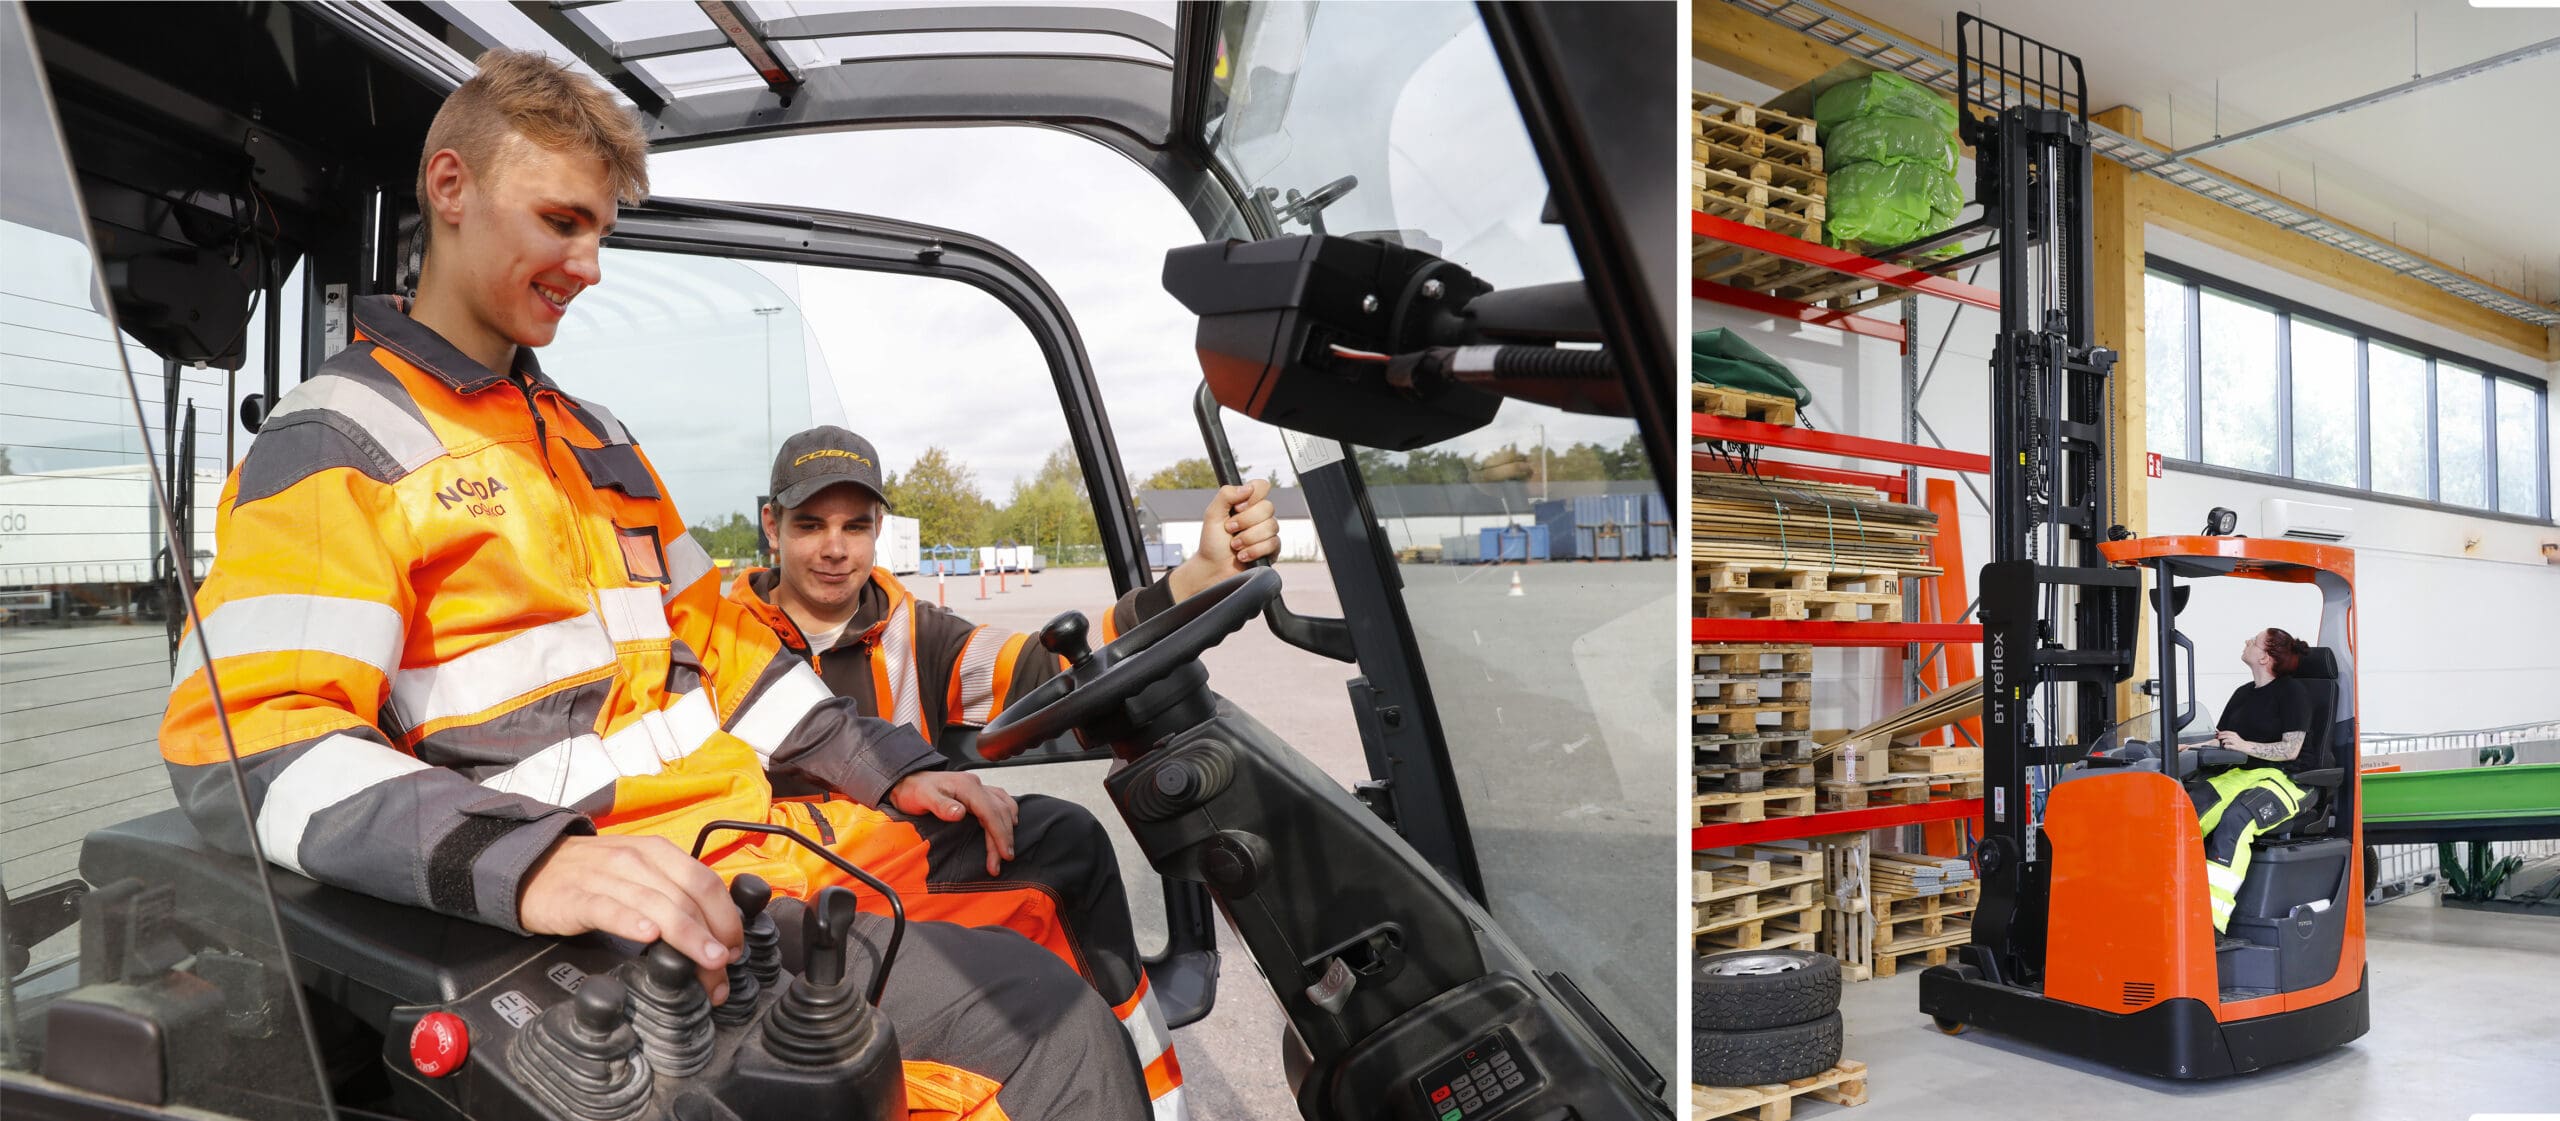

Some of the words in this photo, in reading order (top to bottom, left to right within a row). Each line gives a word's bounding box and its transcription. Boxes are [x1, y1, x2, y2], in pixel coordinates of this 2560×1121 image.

[793, 449, 872, 467] COBRA
[435, 476, 509, 511] NODA
[466, 503, 506, 518] loa
[1884, 580, 1897, 594] FIN
[1991, 632, 2004, 693] reflex
[1994, 700, 2004, 724] BT
[1501, 1065, 1512, 1073] 2
[1507, 1076, 1518, 1085] 3
[1455, 1077, 1465, 1085] 7
[1461, 1089, 1471, 1098] 8
[1467, 1101, 1477, 1109] 9
[1487, 1088, 1498, 1097] 6
